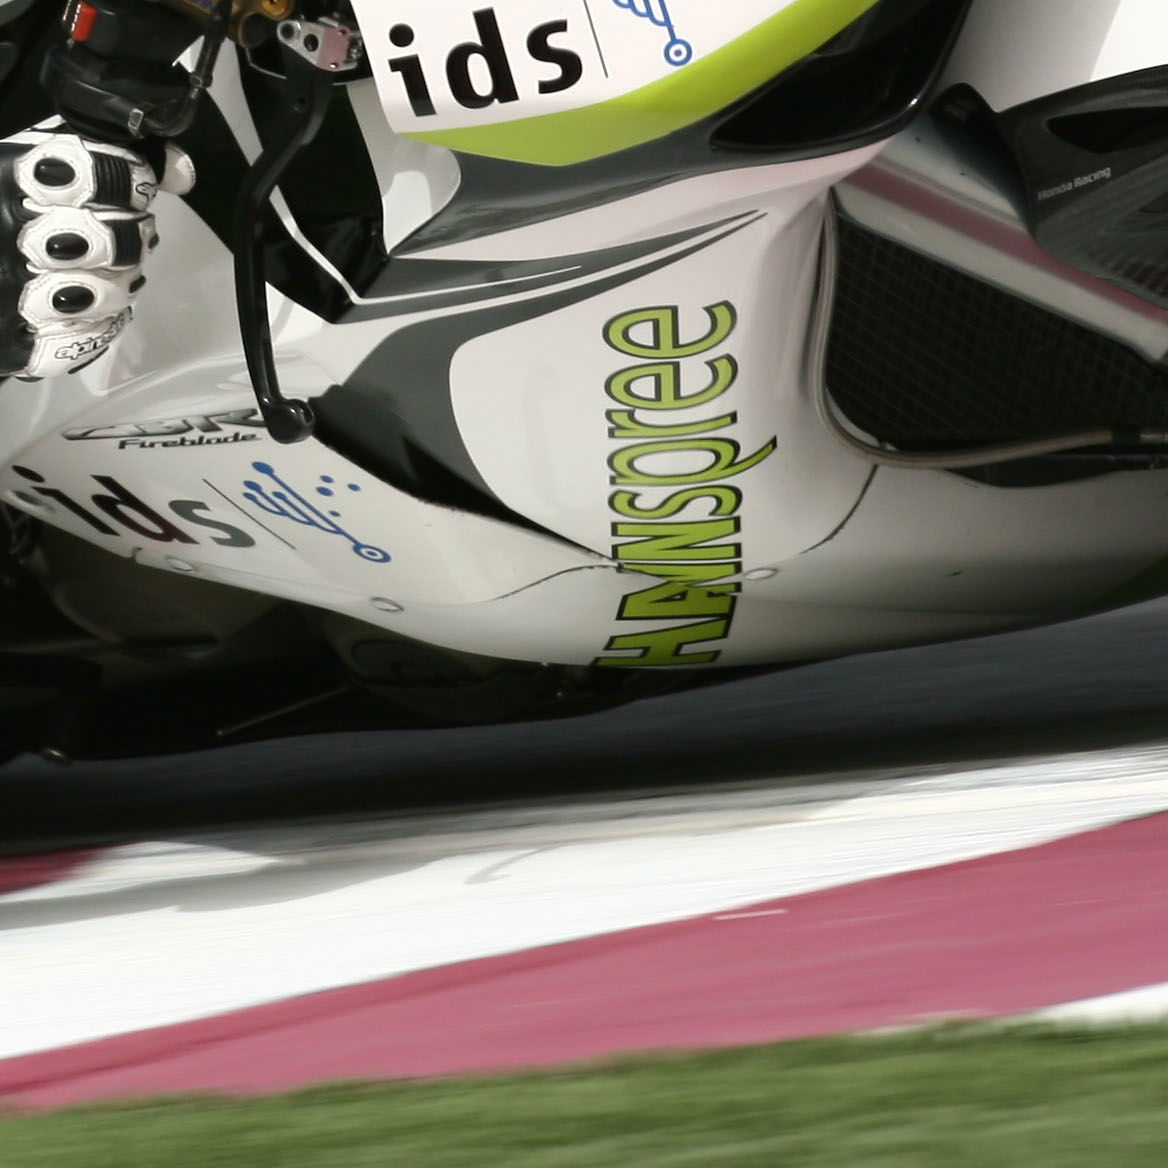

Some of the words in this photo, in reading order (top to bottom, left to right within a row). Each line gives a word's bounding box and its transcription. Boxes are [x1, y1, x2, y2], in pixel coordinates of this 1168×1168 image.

[387, 6, 583, 117] ids
[118, 432, 262, 450] Fireblade
[11, 463, 257, 548] ids
